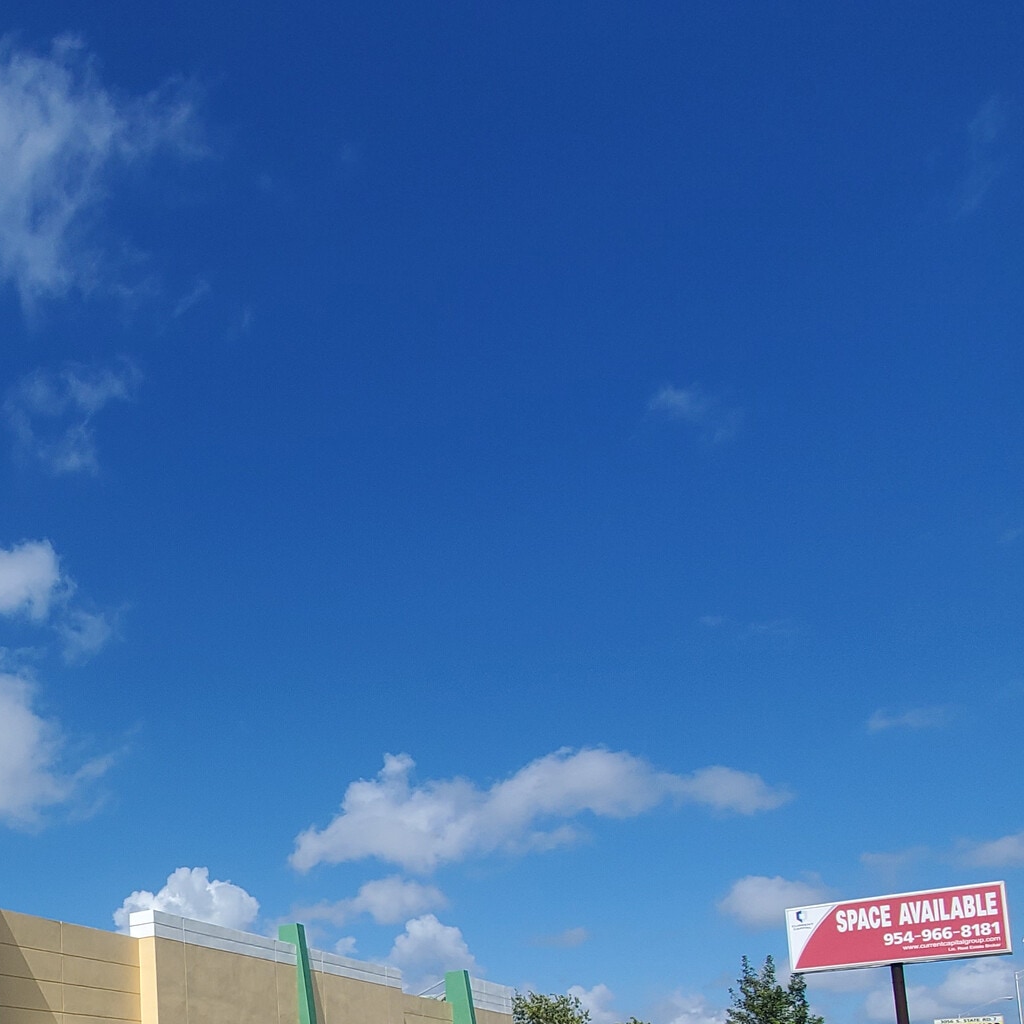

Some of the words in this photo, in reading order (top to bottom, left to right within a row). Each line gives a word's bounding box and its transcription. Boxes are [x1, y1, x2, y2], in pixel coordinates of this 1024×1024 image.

[835, 904, 892, 933] SPACE
[898, 891, 999, 926] AVAILABLE
[883, 921, 1001, 946] 954-966-8181
